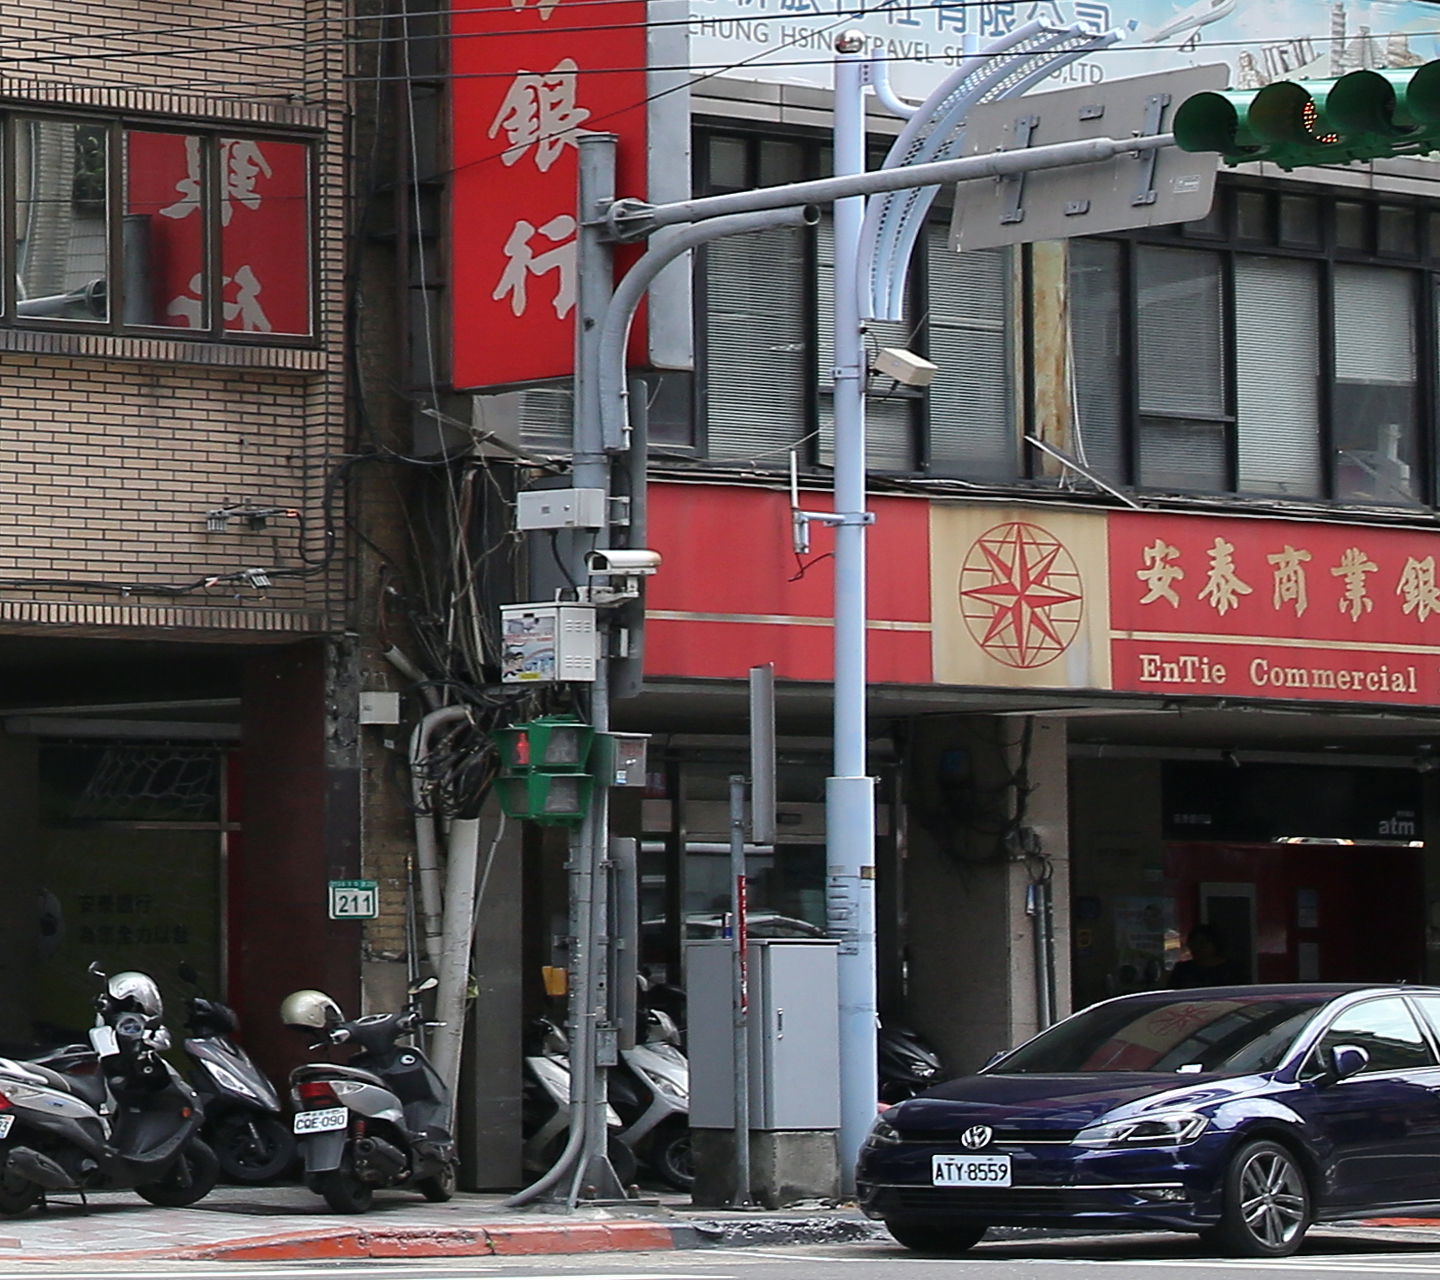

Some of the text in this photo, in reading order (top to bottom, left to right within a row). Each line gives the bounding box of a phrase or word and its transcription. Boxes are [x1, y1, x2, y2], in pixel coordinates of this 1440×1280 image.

[1136, 537, 1440, 623] 安泰商業銀
[1139, 654, 1418, 693] EnTie Commercial
[1378, 818, 1415, 835] atm
[338, 894, 371, 913] 211
[935, 1162, 1008, 1181] ATY-8559
